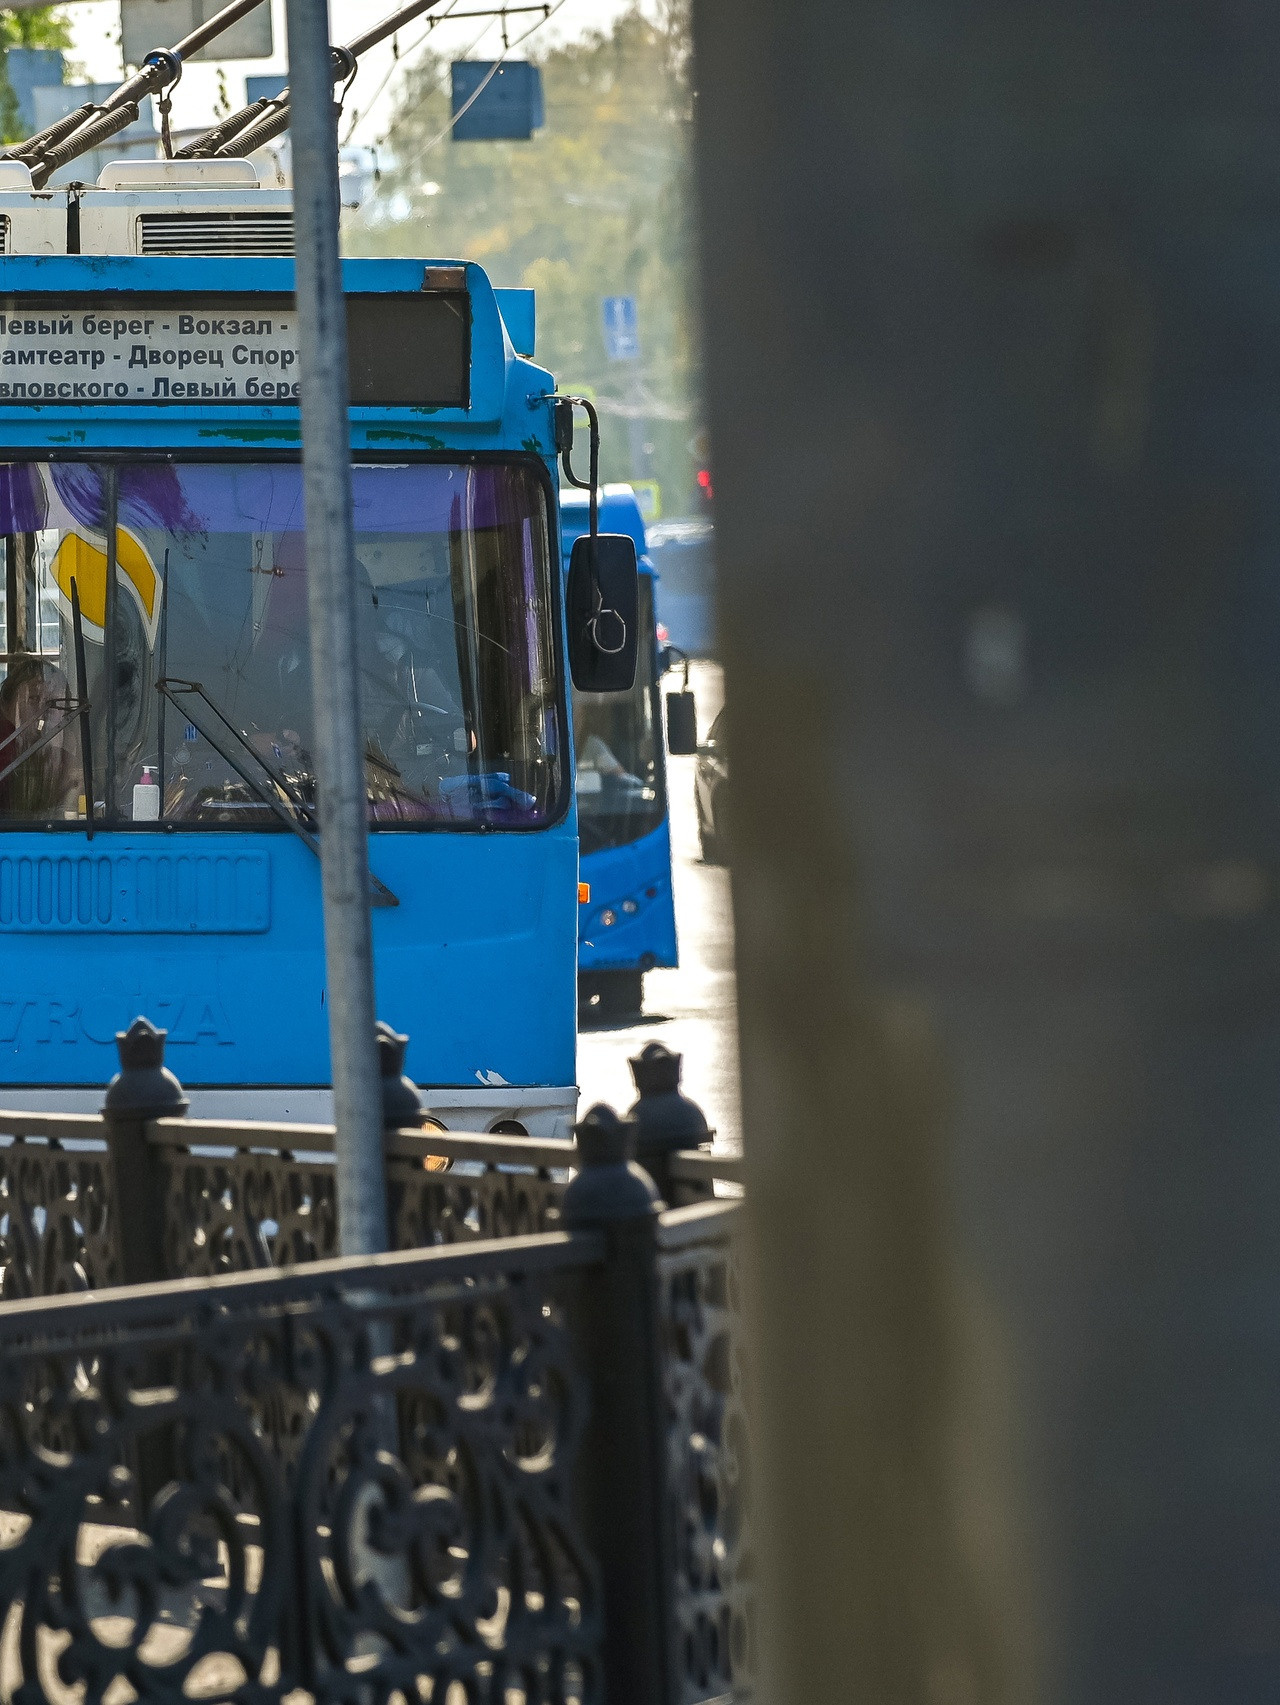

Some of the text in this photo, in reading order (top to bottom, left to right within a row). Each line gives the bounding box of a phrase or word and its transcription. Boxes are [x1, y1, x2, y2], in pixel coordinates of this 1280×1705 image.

[82, 314, 155, 340] берег
[178, 315, 272, 335] Вокзал
[128, 345, 224, 369] Дворец
[152, 377, 236, 397] Левый
